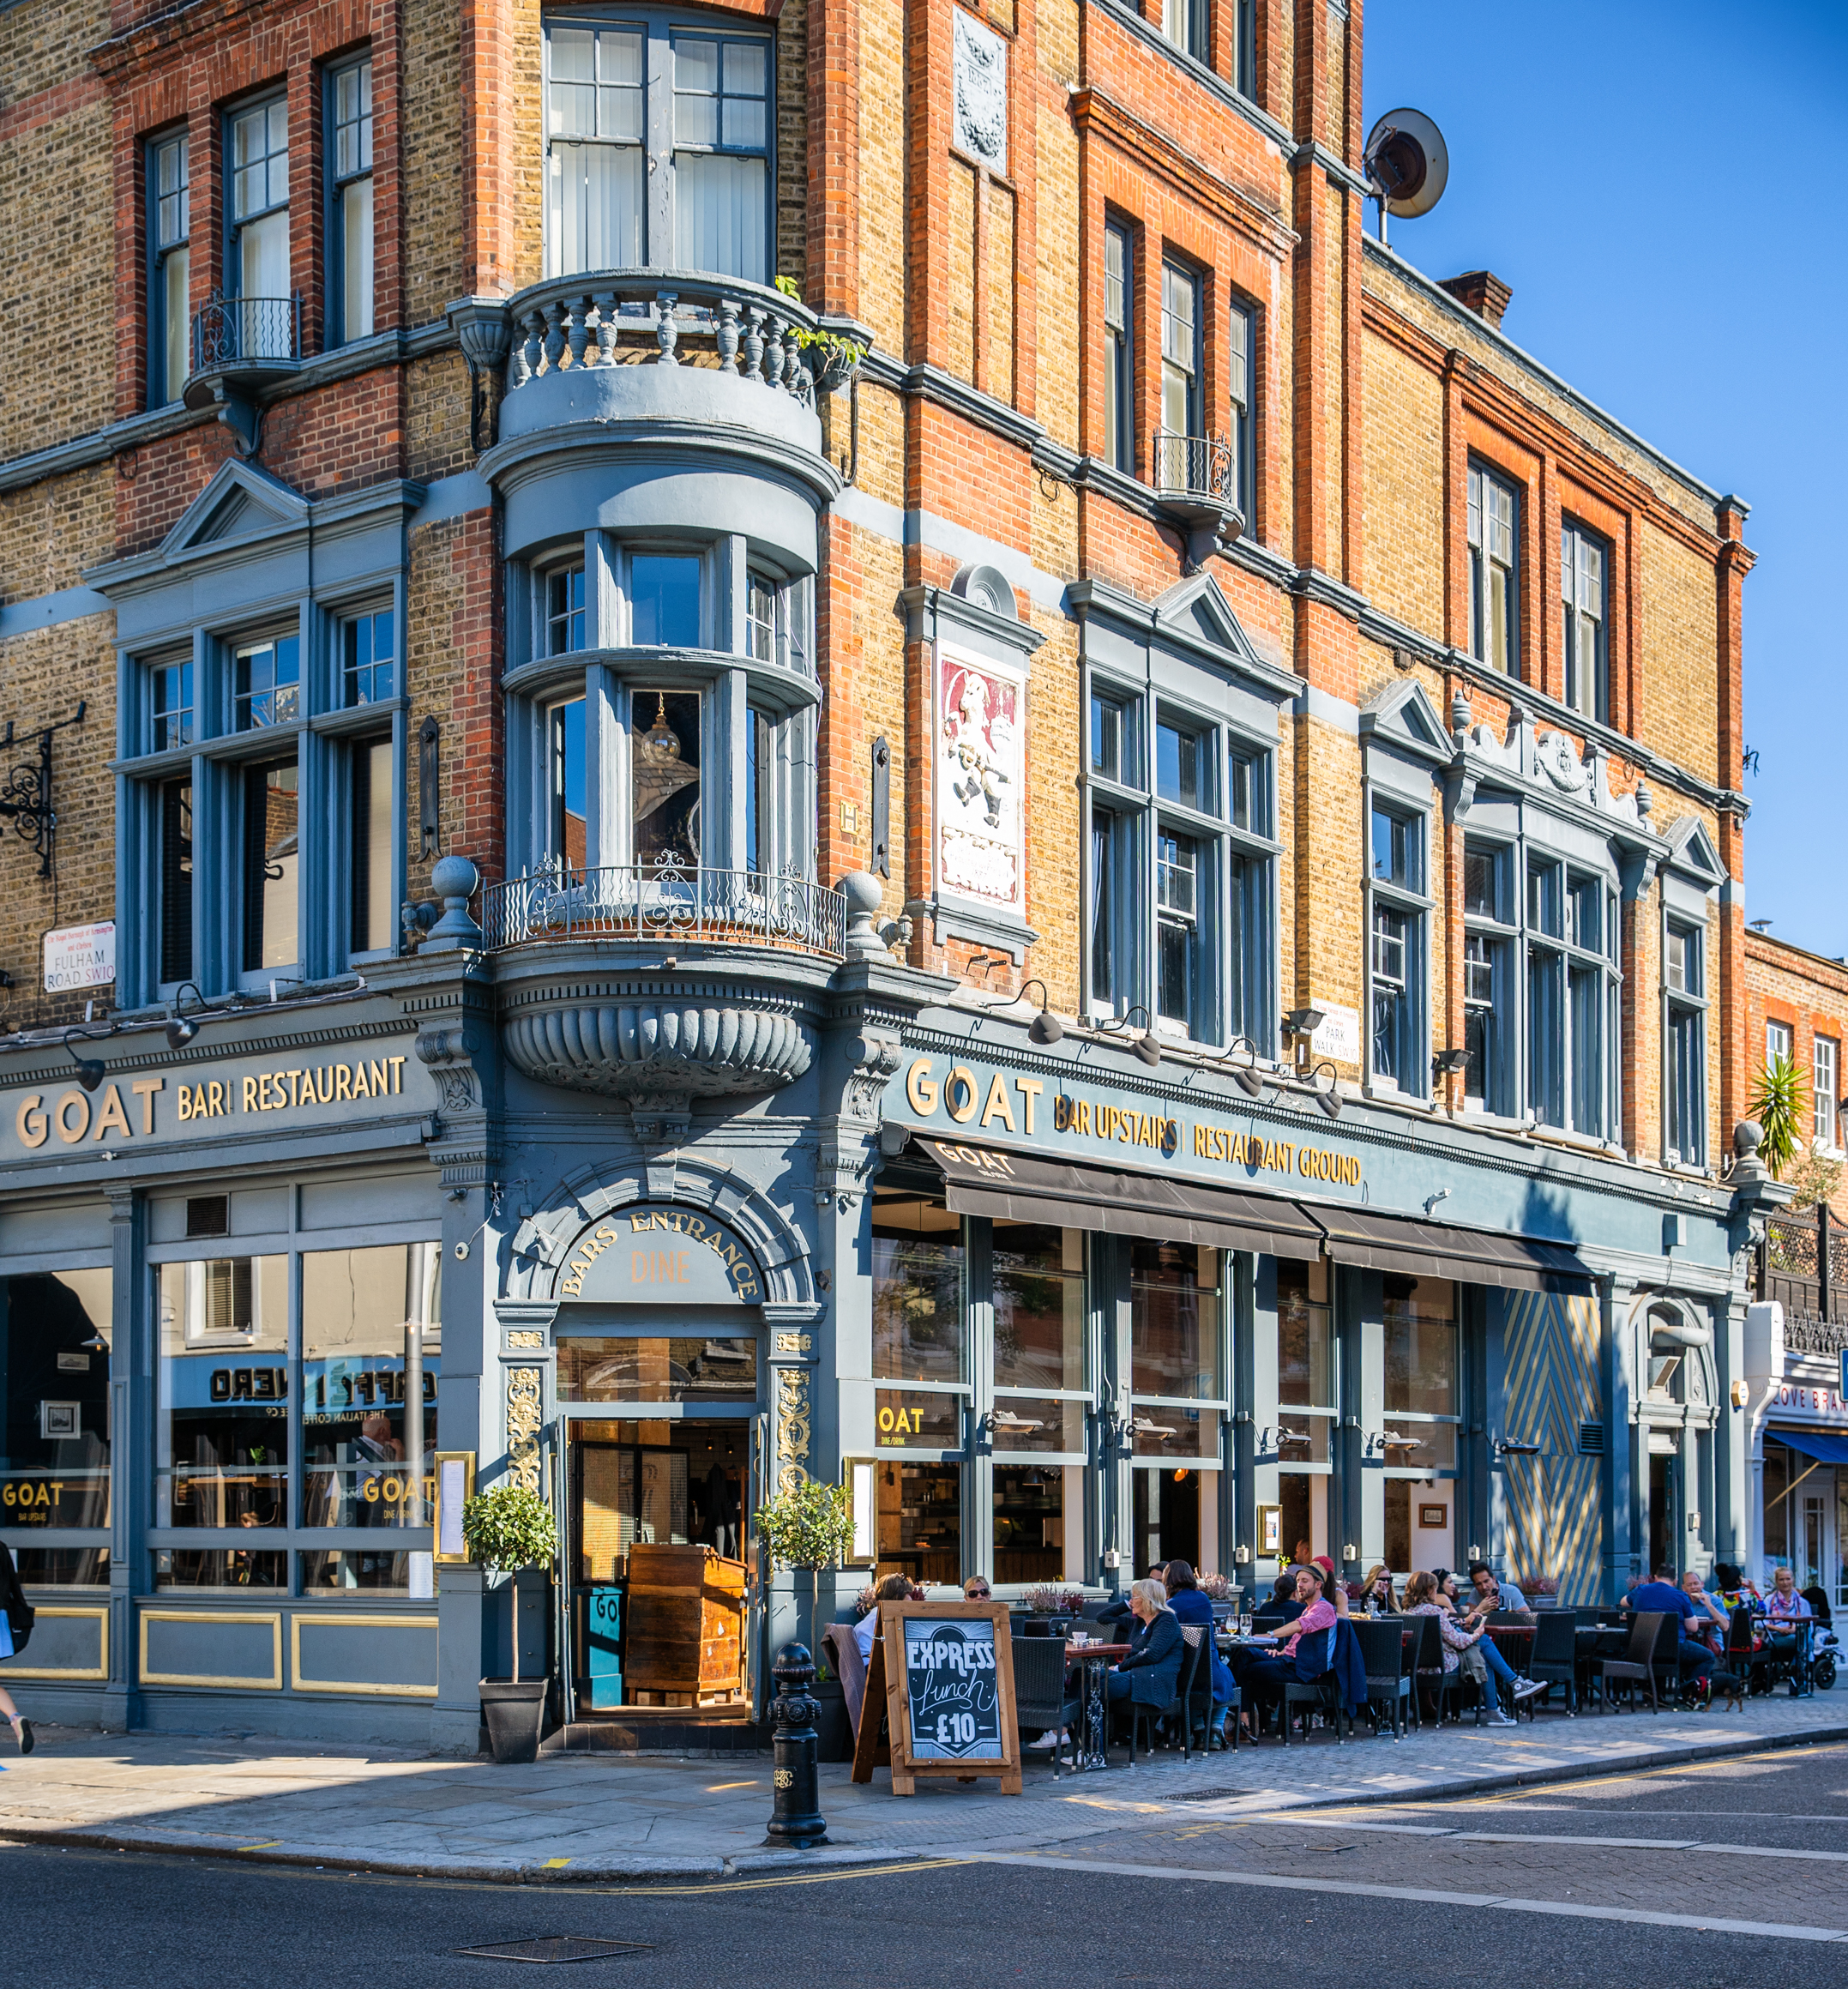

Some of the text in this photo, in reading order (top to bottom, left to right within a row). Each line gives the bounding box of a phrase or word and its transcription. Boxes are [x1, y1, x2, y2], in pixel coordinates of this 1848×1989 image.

[55, 949, 105, 971] FULHAM
[1326, 1026, 1345, 1042] PARK
[15, 1056, 407, 1148] GOAT BAR RESTAURANT
[906, 1058, 1362, 1187] GOAT BAR UPSTAIRS RESTAURANT GROUND
[935, 1142, 1016, 1175] GOAT
[561, 1210, 760, 1300] BARS ENTRANCE
[631, 1251, 690, 1283] DINE
[875, 1407, 924, 1433] OAT
[2, 1482, 63, 1506] GOAT
[363, 1476, 435, 1503] GOAT
[907, 1641, 996, 1677] EXPRESS
[936, 1712, 976, 1743] £10
